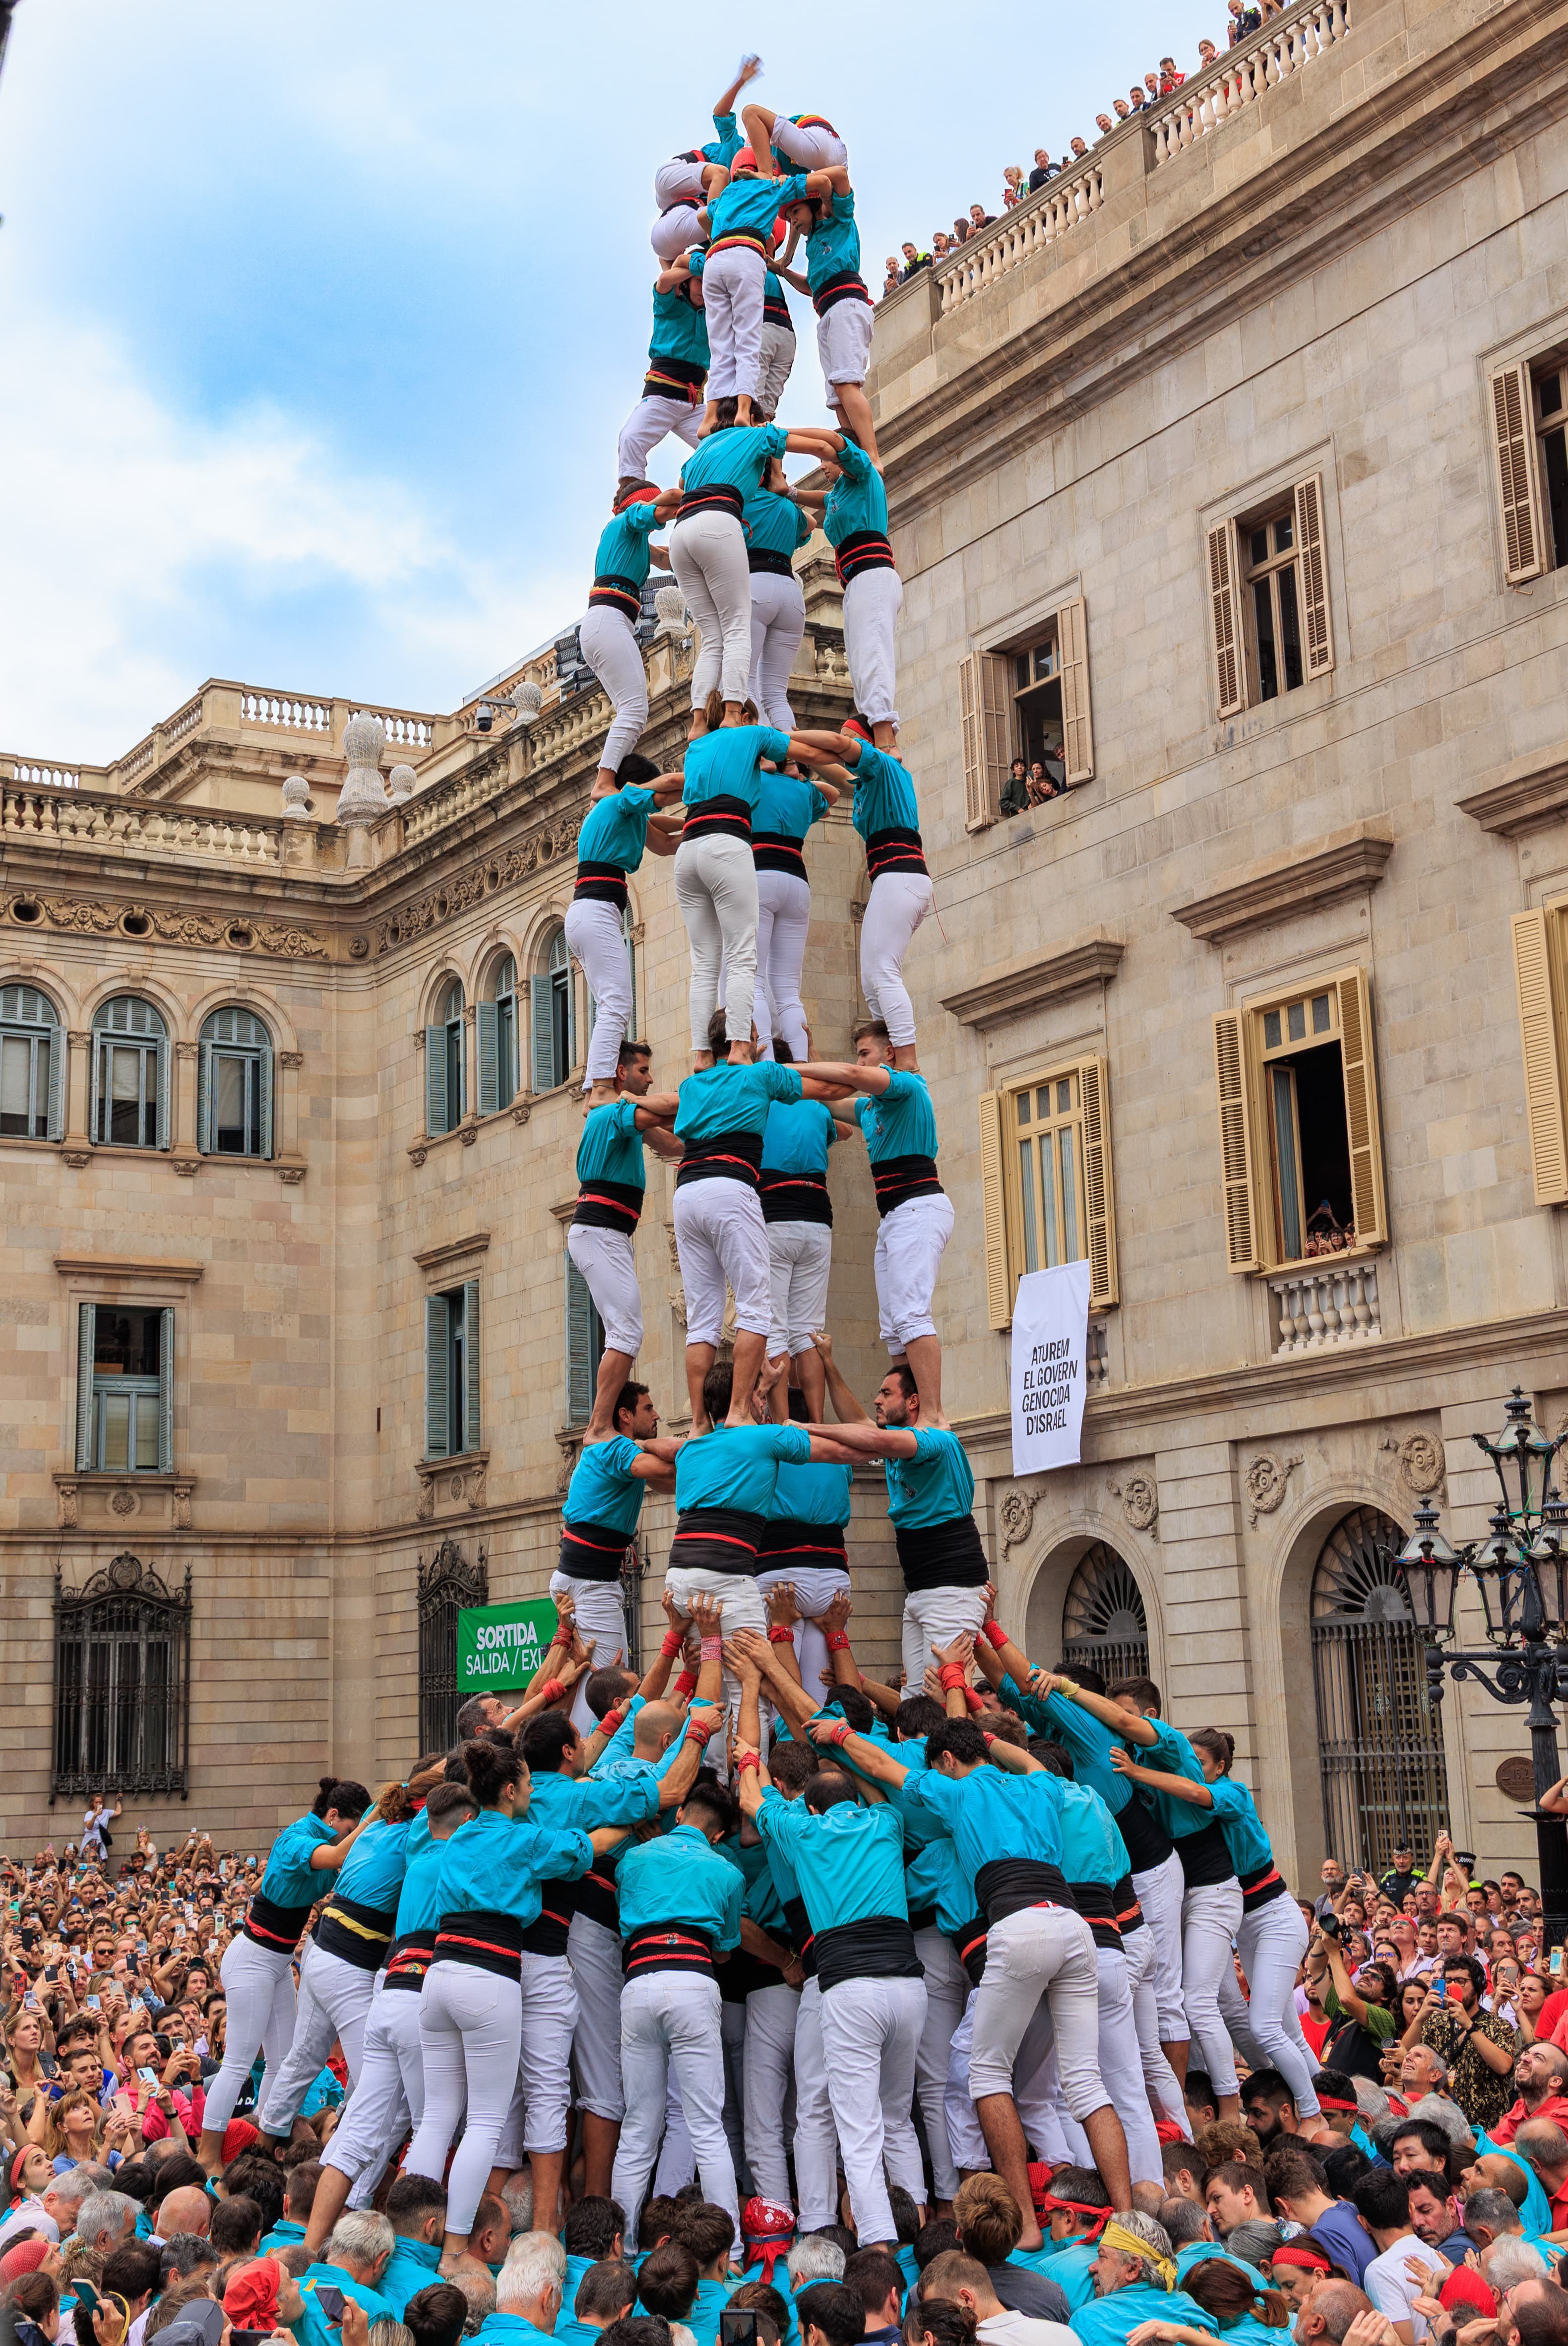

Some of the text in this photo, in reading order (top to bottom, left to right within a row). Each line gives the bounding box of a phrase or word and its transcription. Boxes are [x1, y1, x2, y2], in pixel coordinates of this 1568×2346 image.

[1031, 1338, 1070, 1366] ATUREM
[1023, 1360, 1078, 1390] EL GOVERN
[1022, 1384, 1070, 1413] GENOCIDA
[1026, 1408, 1067, 1436] D'ISRAEL
[476, 1621, 538, 1650] SORTIDA
[466, 1651, 510, 1676] SALIDA
[522, 1647, 543, 1671] EXI
